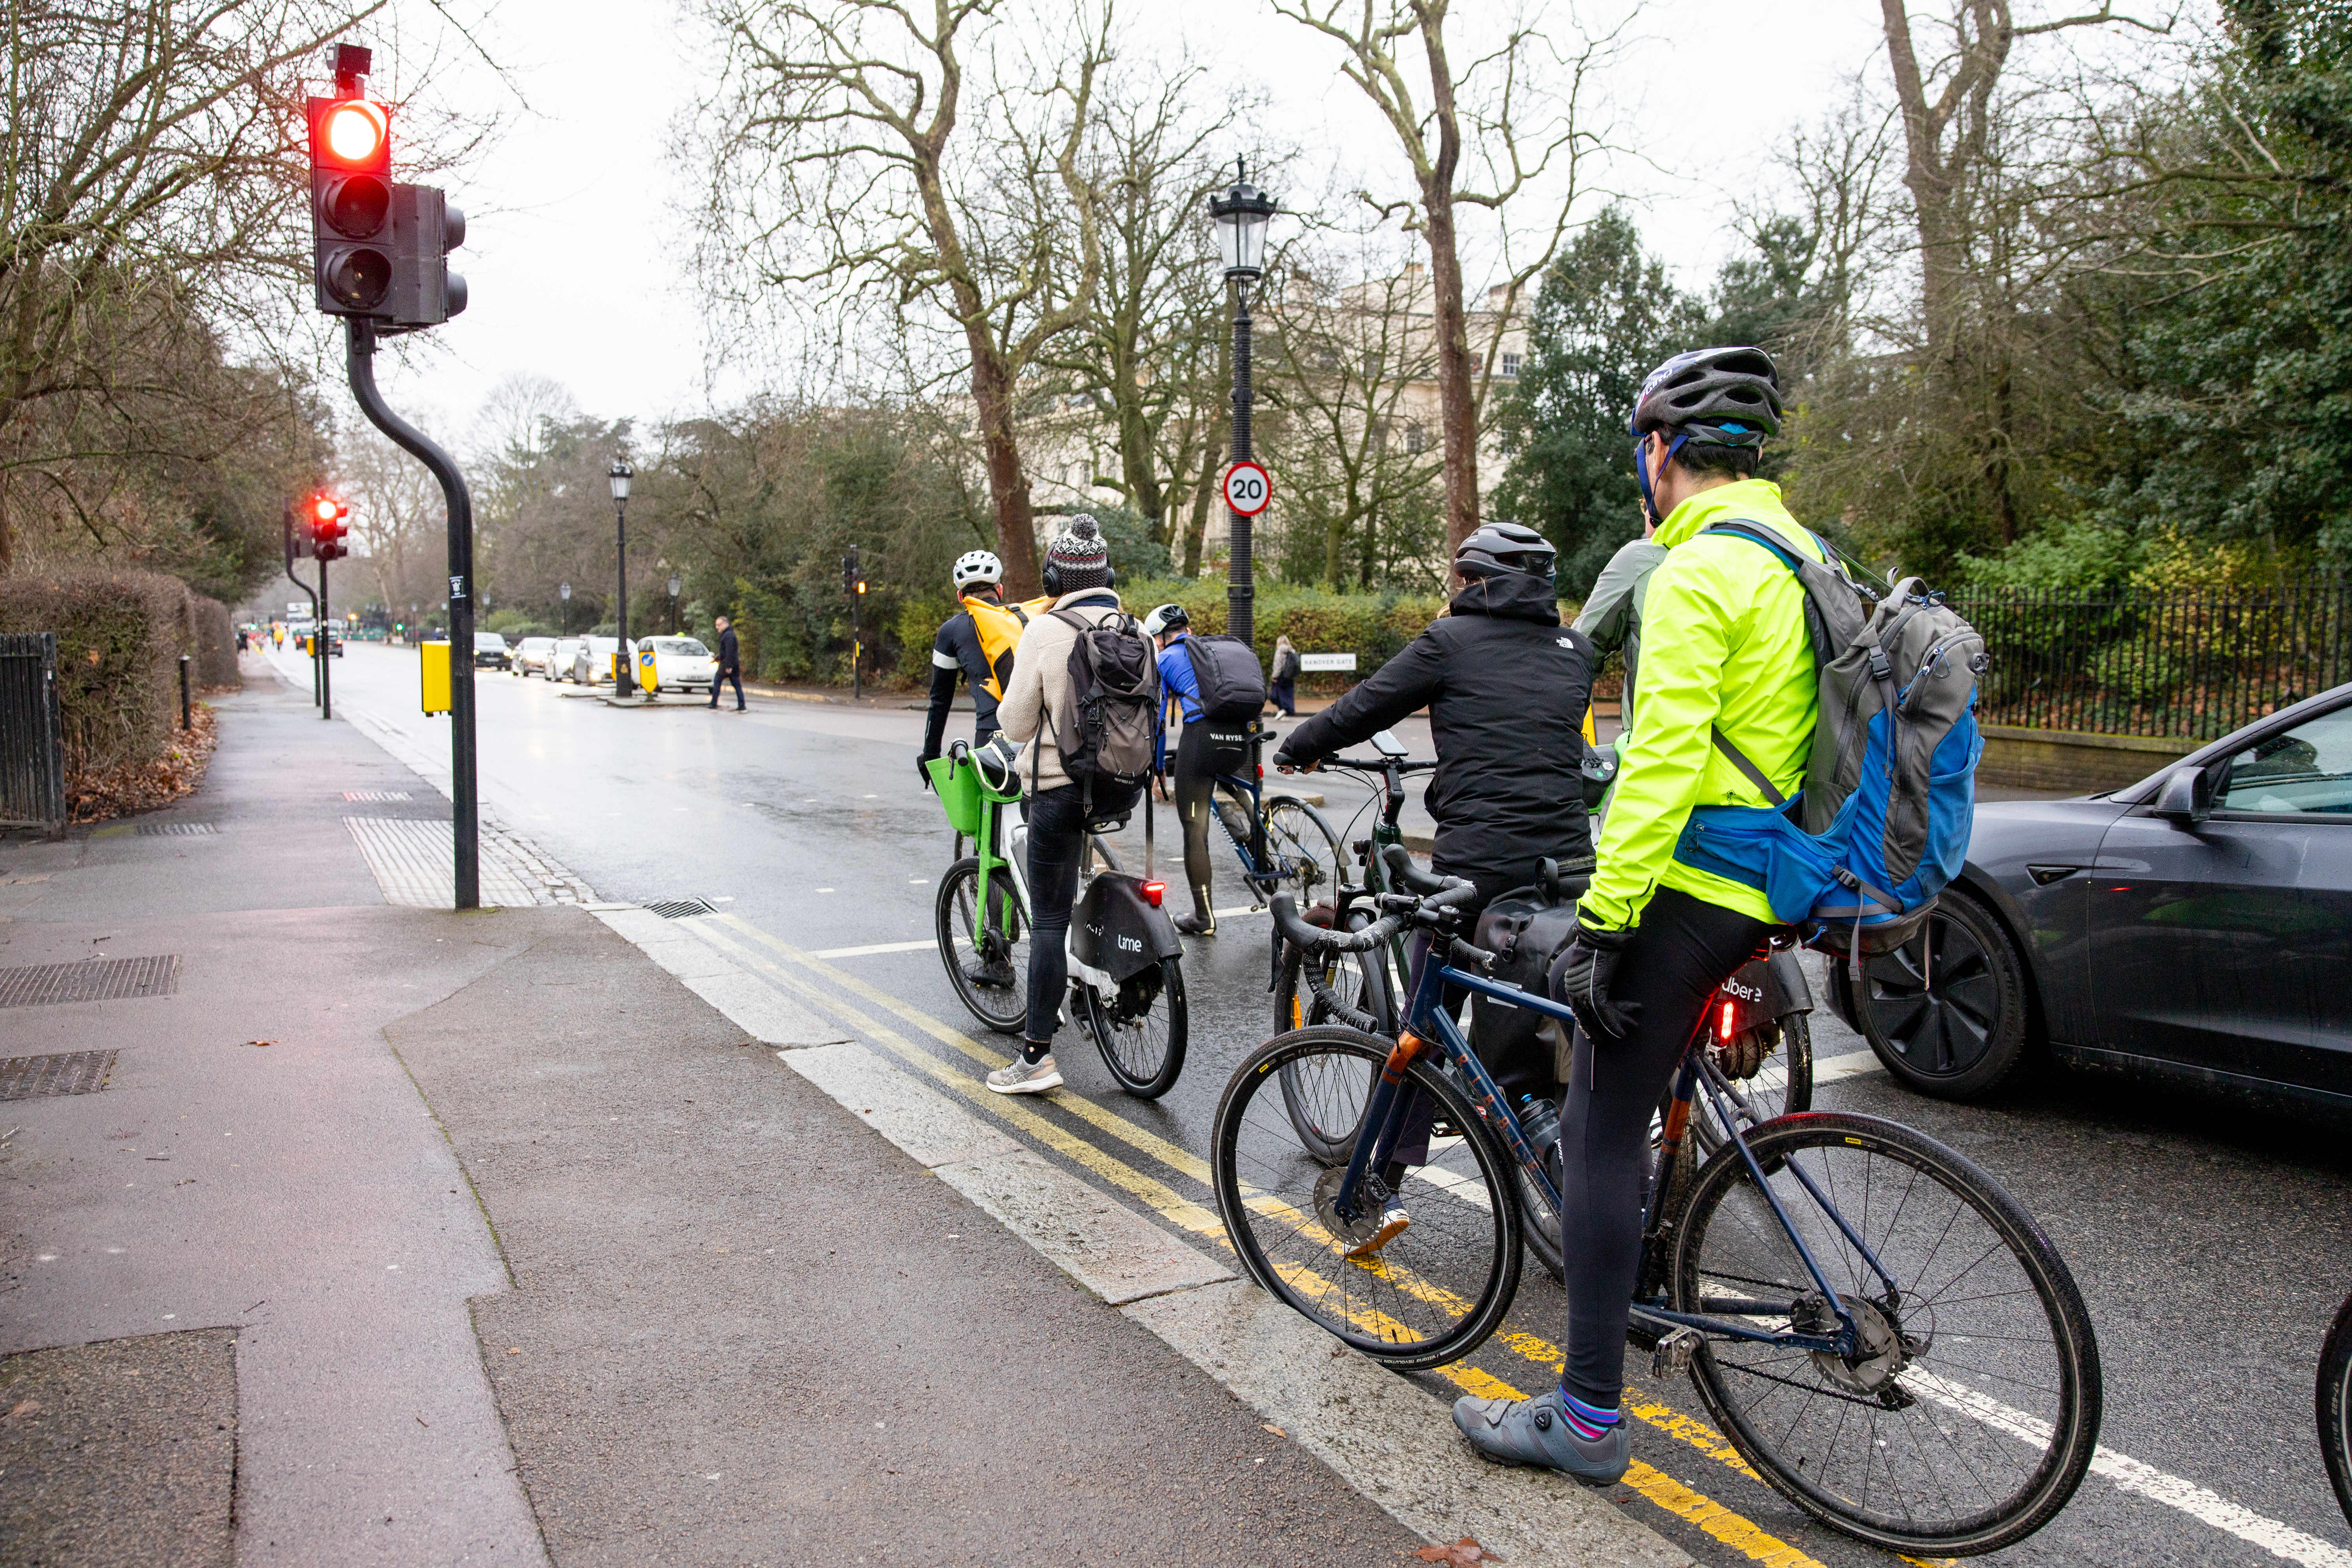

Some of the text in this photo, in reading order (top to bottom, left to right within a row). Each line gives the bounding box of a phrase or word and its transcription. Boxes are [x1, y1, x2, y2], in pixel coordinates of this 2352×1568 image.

[1645, 369, 1672, 395] GIRO
[1233, 479, 1261, 499] 20
[1722, 976, 1753, 1000] Uber
[1456, 1053, 1539, 1171] RIBBLE
[1757, 1463, 1794, 1496] REVOLUTION
